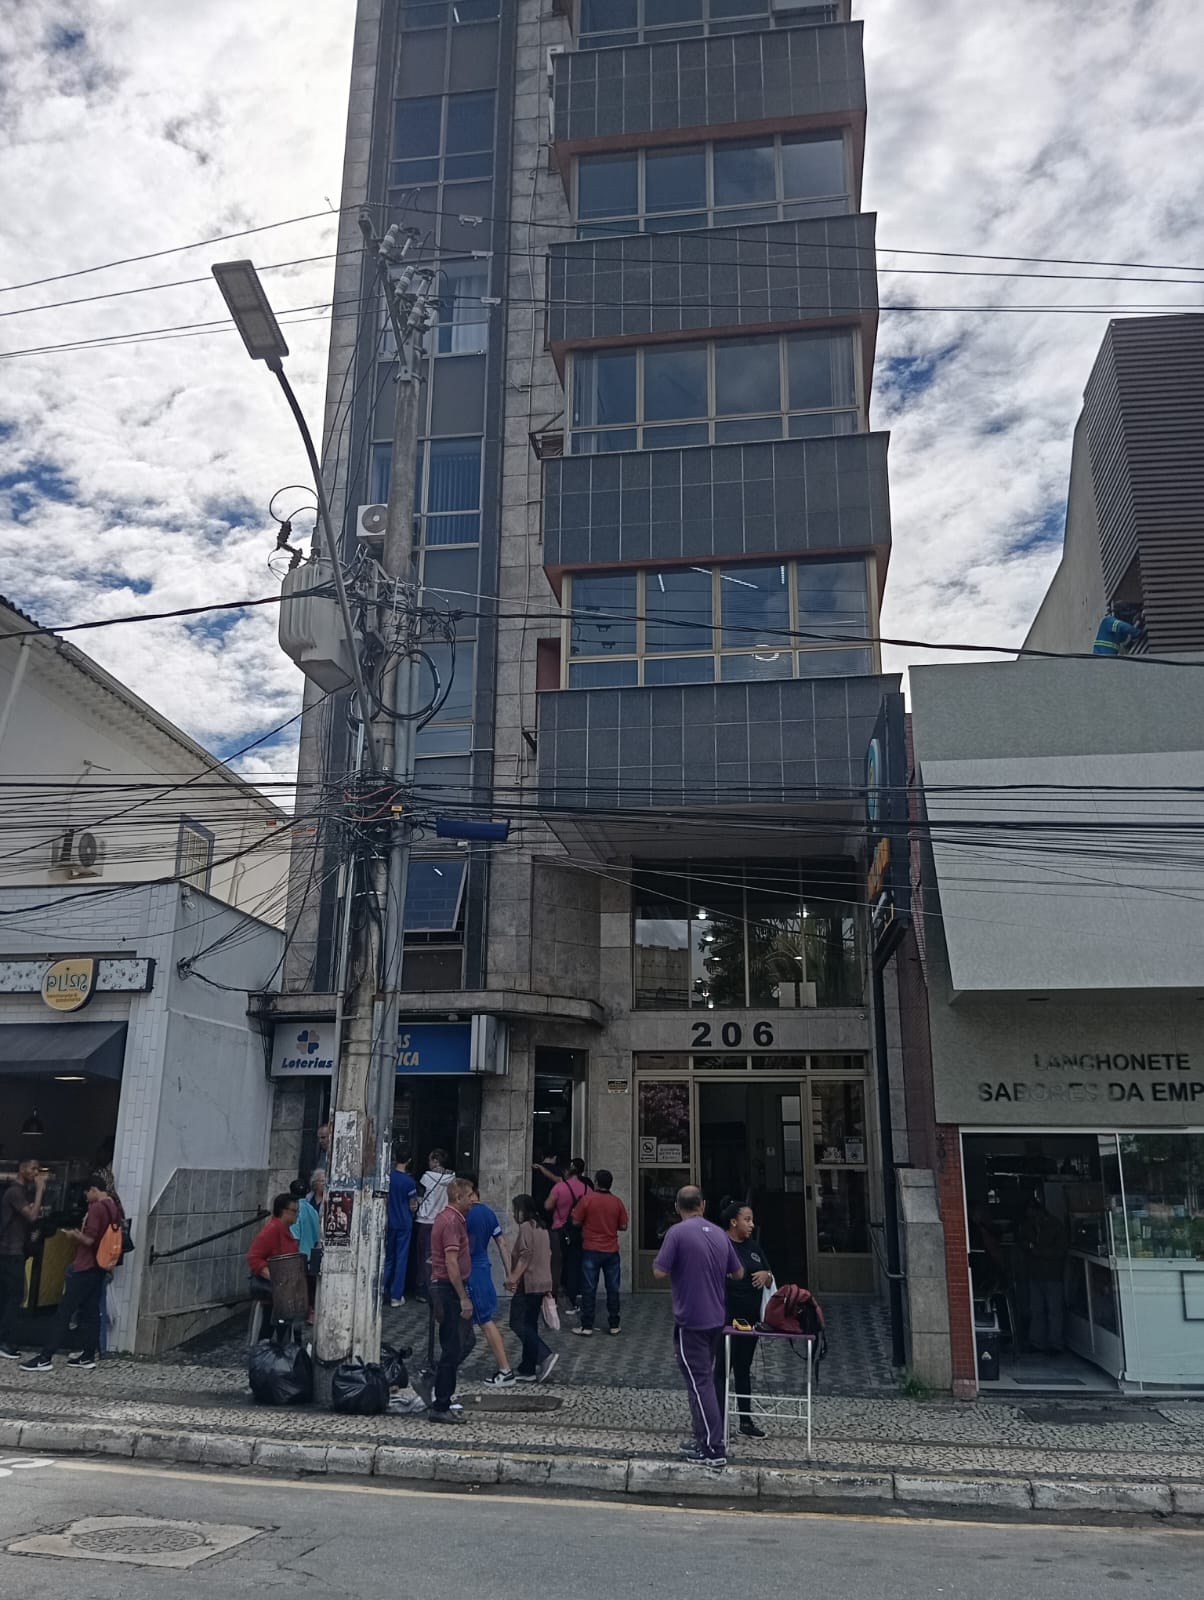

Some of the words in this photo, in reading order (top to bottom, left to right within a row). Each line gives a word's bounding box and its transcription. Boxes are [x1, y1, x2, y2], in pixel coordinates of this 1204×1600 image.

[691, 1021, 774, 1047] 206
[281, 1057, 333, 1069] Loterias
[397, 1051, 420, 1066] ICA
[1033, 1053, 1191, 1071] LANCHONETE
[1108, 1082, 1145, 1102] DA
